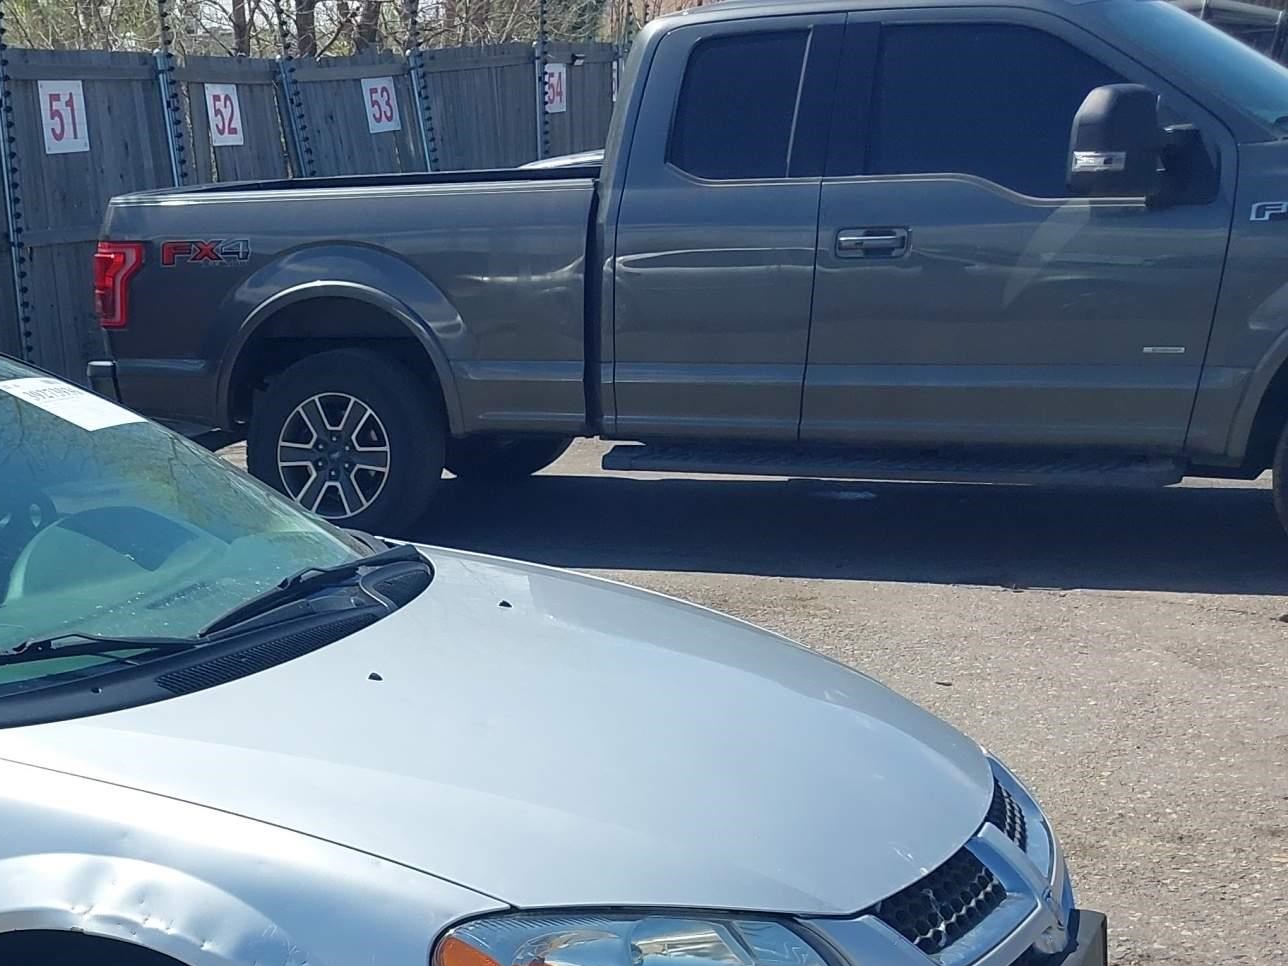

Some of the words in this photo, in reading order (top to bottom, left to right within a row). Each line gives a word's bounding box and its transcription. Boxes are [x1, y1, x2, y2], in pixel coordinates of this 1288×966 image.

[369, 86, 394, 123] 53
[547, 71, 564, 105] 54
[48, 92, 78, 142] 51
[212, 94, 238, 136] 52
[160, 239, 252, 267] FX4
